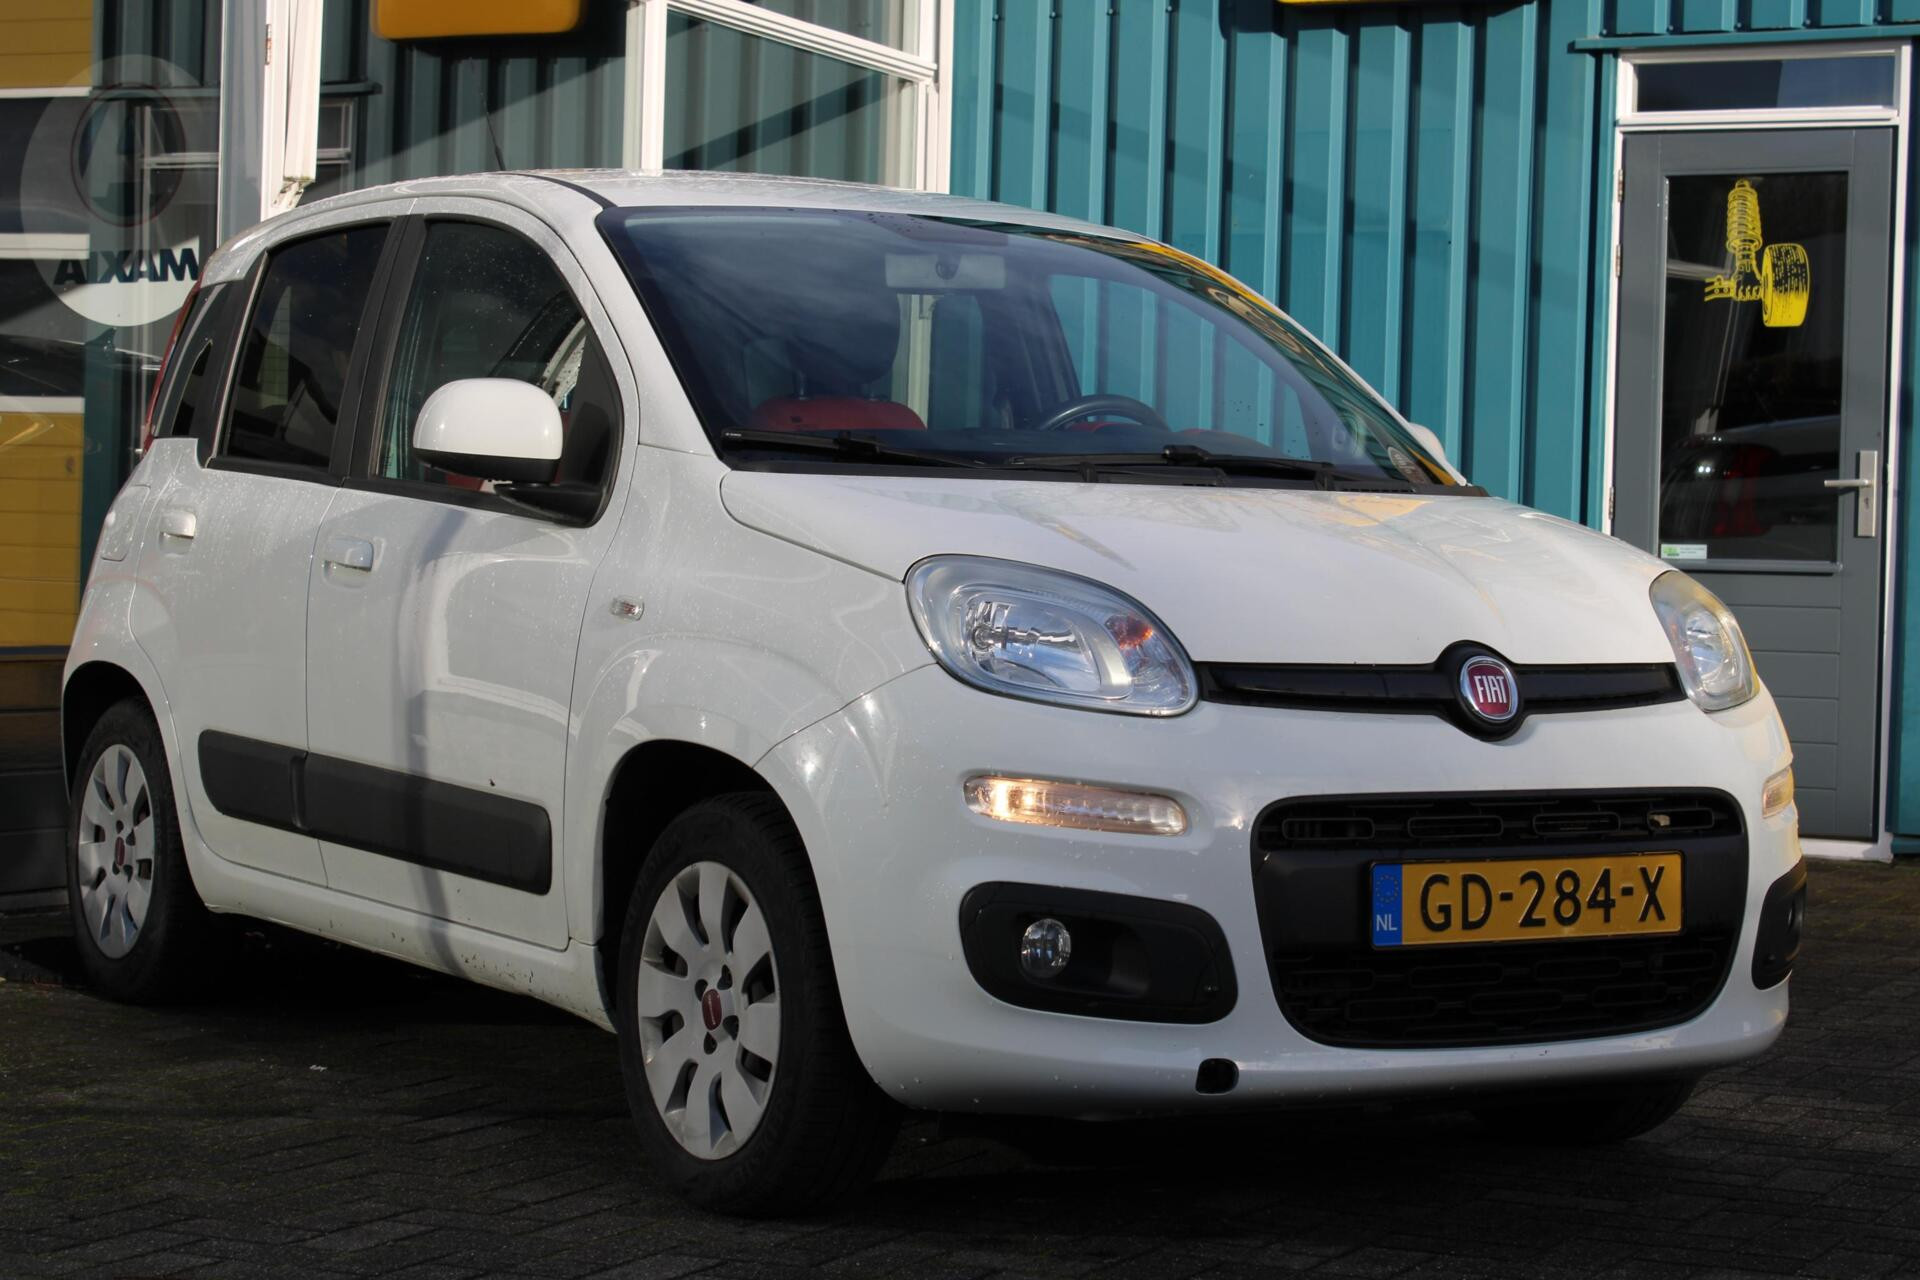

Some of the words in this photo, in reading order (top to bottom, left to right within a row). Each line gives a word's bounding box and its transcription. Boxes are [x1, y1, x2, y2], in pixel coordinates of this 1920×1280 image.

[53, 248, 199, 285] AIXAM
[1473, 675, 1507, 704] FIAT
[1419, 865, 1666, 933] GD-284-X
[1375, 914, 1398, 932] NL
